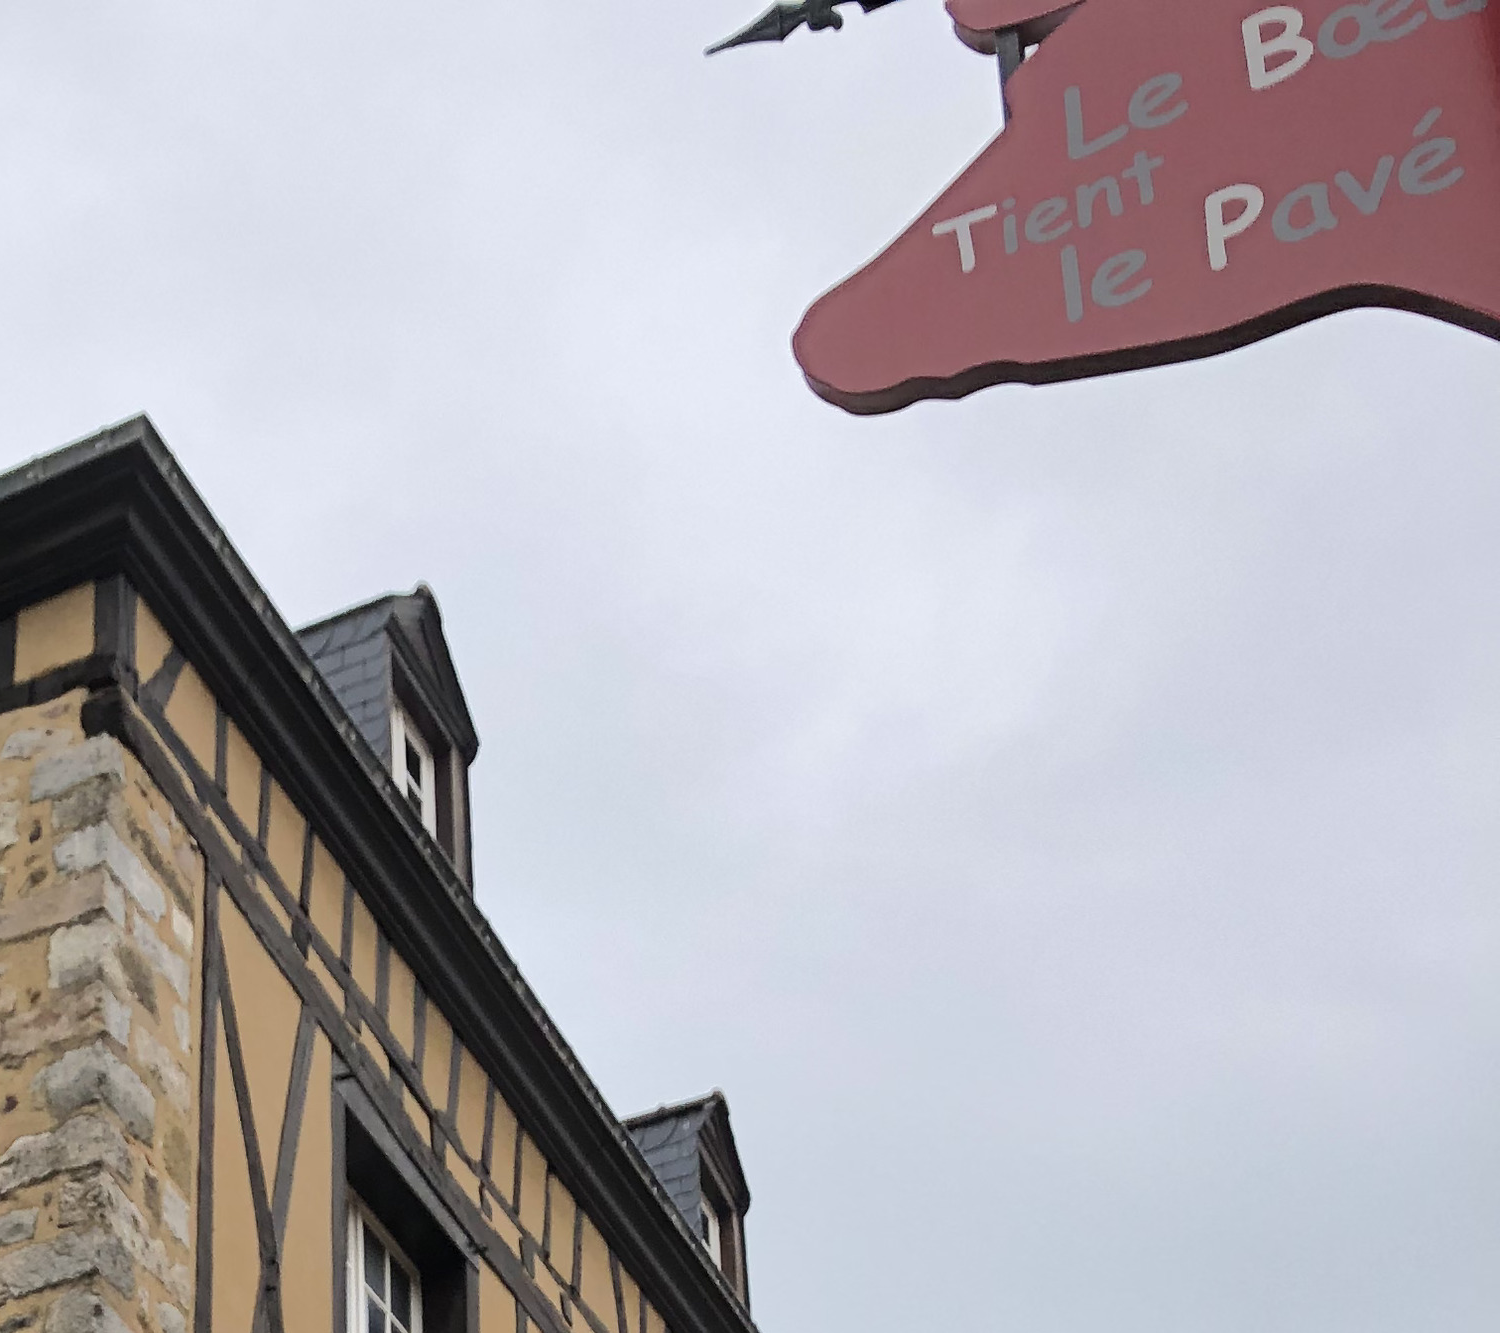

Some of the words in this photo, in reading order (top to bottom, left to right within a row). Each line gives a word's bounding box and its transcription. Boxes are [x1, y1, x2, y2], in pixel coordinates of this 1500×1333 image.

[1064, 72, 1188, 160] Le
[932, 149, 1165, 273] Tient
[1060, 245, 1153, 323] le
[1204, 107, 1465, 271] Pavé
